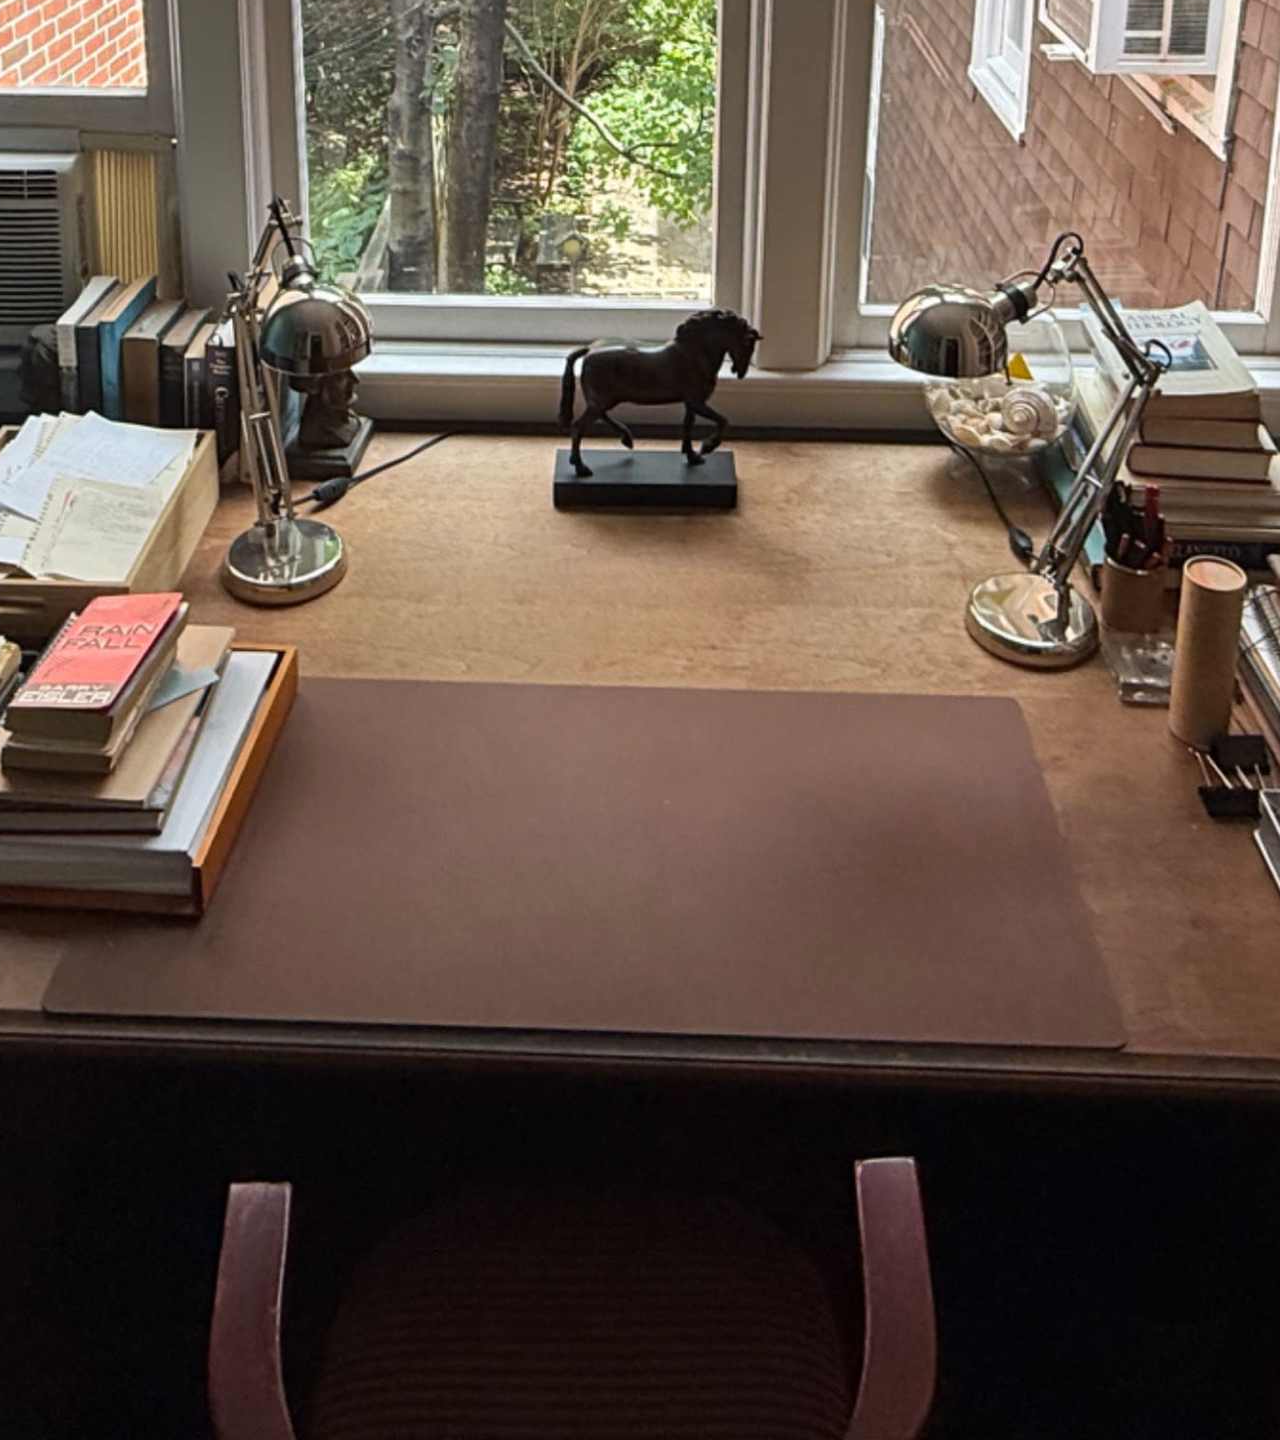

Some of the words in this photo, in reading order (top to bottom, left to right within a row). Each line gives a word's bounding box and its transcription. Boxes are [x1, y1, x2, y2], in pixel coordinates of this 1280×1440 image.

[78, 623, 159, 637] RAIN
[62, 637, 140, 650] FALL
[38, 683, 104, 691] BARRY
[18, 690, 112, 704] EISLER
